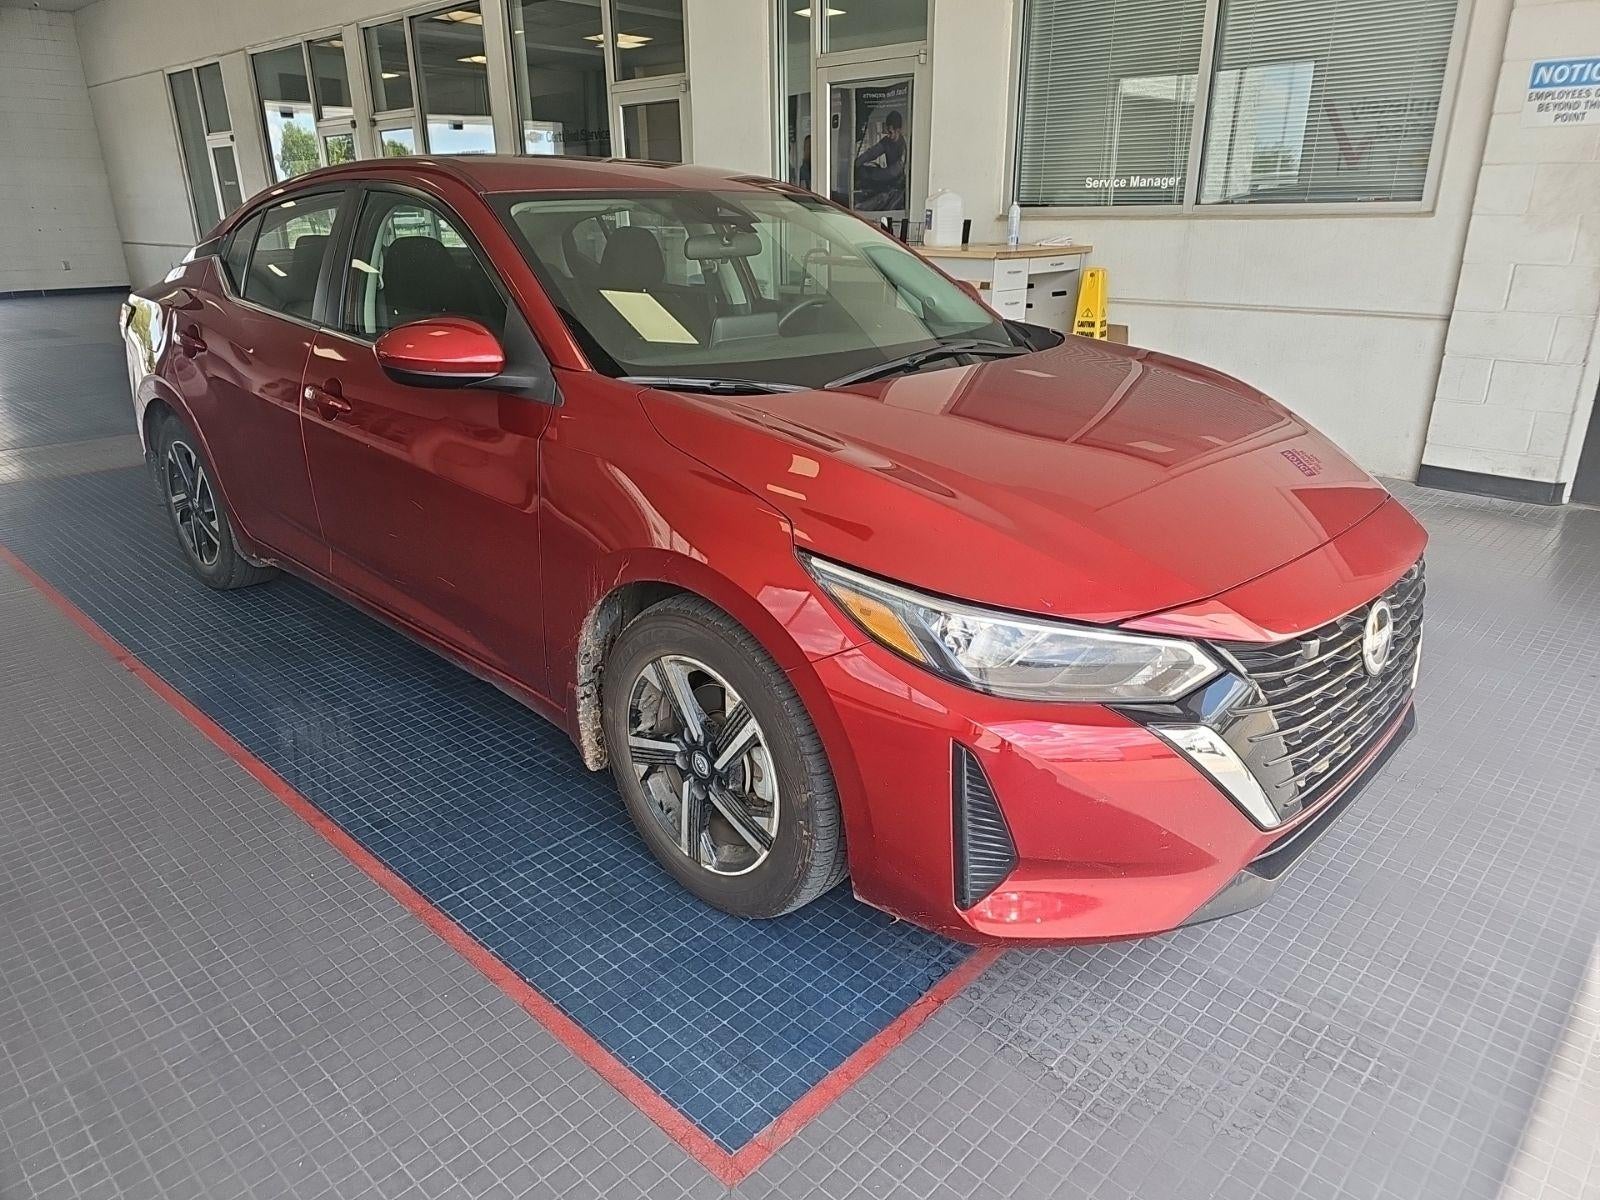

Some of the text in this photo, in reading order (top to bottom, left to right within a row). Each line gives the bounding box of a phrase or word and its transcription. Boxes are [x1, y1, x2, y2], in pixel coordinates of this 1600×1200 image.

[1528, 89, 1592, 102] EMPLOYEES
[1537, 101, 1581, 112] BEYOND
[1553, 111, 1587, 123] POINT
[581, 127, 610, 140] Service
[1085, 176, 1181, 189] Service Manager
[1077, 320, 1095, 328] CAUTION
